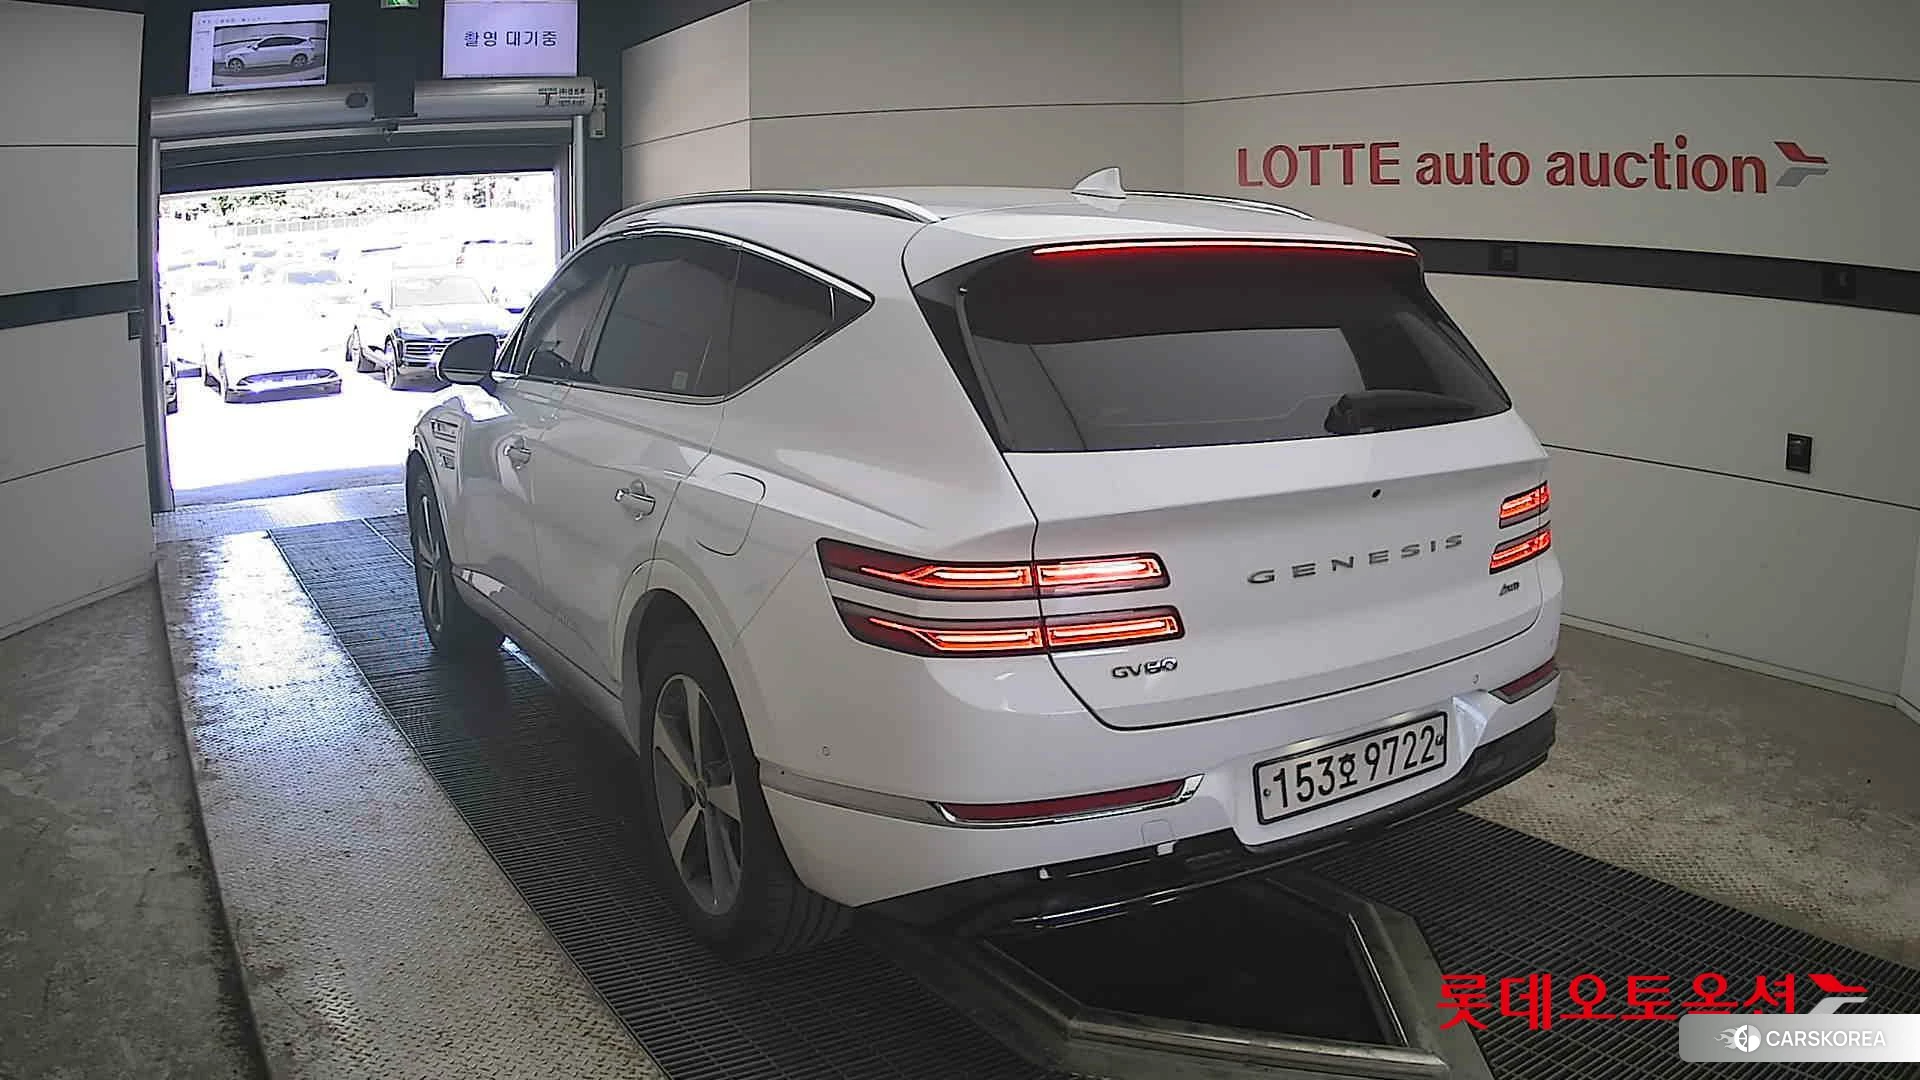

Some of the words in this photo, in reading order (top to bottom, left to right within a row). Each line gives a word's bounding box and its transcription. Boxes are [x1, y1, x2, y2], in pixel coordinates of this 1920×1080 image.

[465, 31, 497, 47] 촬영
[506, 31, 557, 47] 대기중
[1237, 141, 1400, 188] LOTTE
[1415, 142, 1530, 186] auto
[1546, 134, 1767, 194] auction
[1247, 534, 1463, 584] GENESIS
[1273, 753, 1358, 808] 153호
[1364, 725, 1436, 781] 9722
